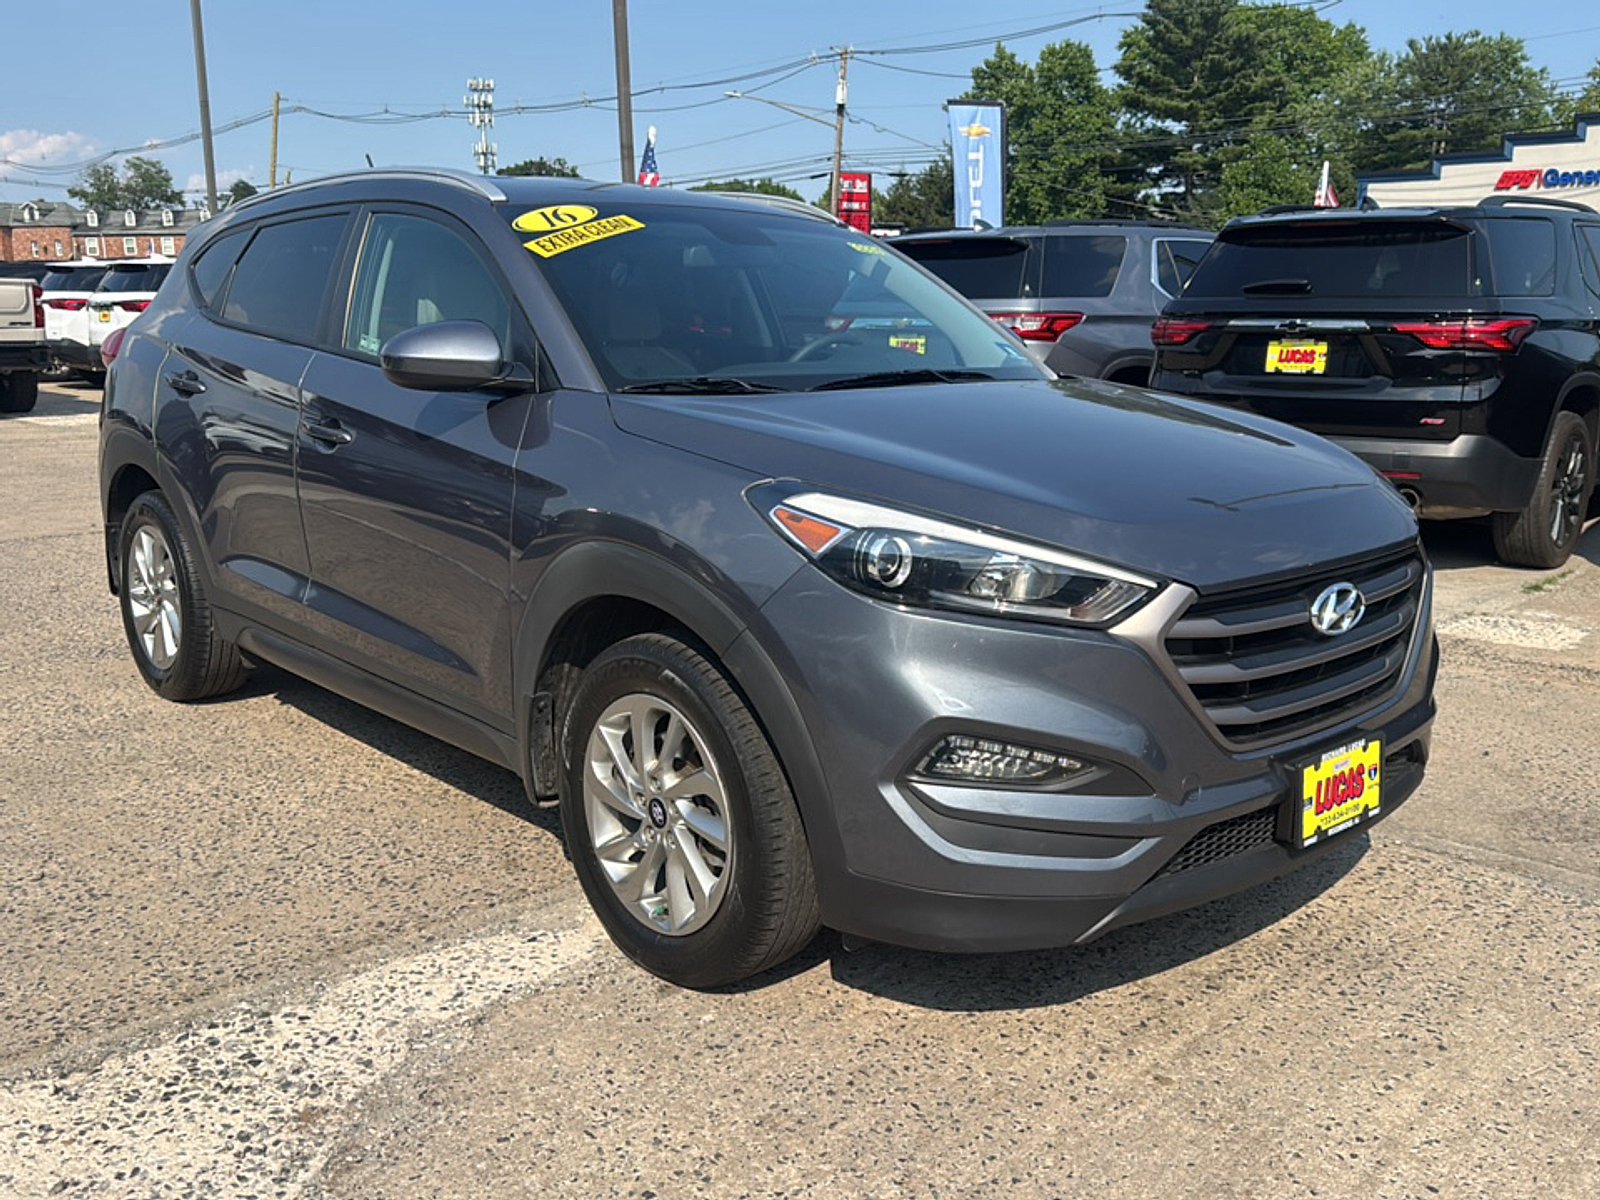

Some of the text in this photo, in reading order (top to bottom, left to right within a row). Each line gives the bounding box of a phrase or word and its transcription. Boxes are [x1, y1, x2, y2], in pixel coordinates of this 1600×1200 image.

[538, 208, 578, 228] 16
[535, 217, 633, 252] EXTRA CLEAN
[1278, 348, 1316, 364] LUCAS
[1315, 763, 1365, 815] LUCAS
